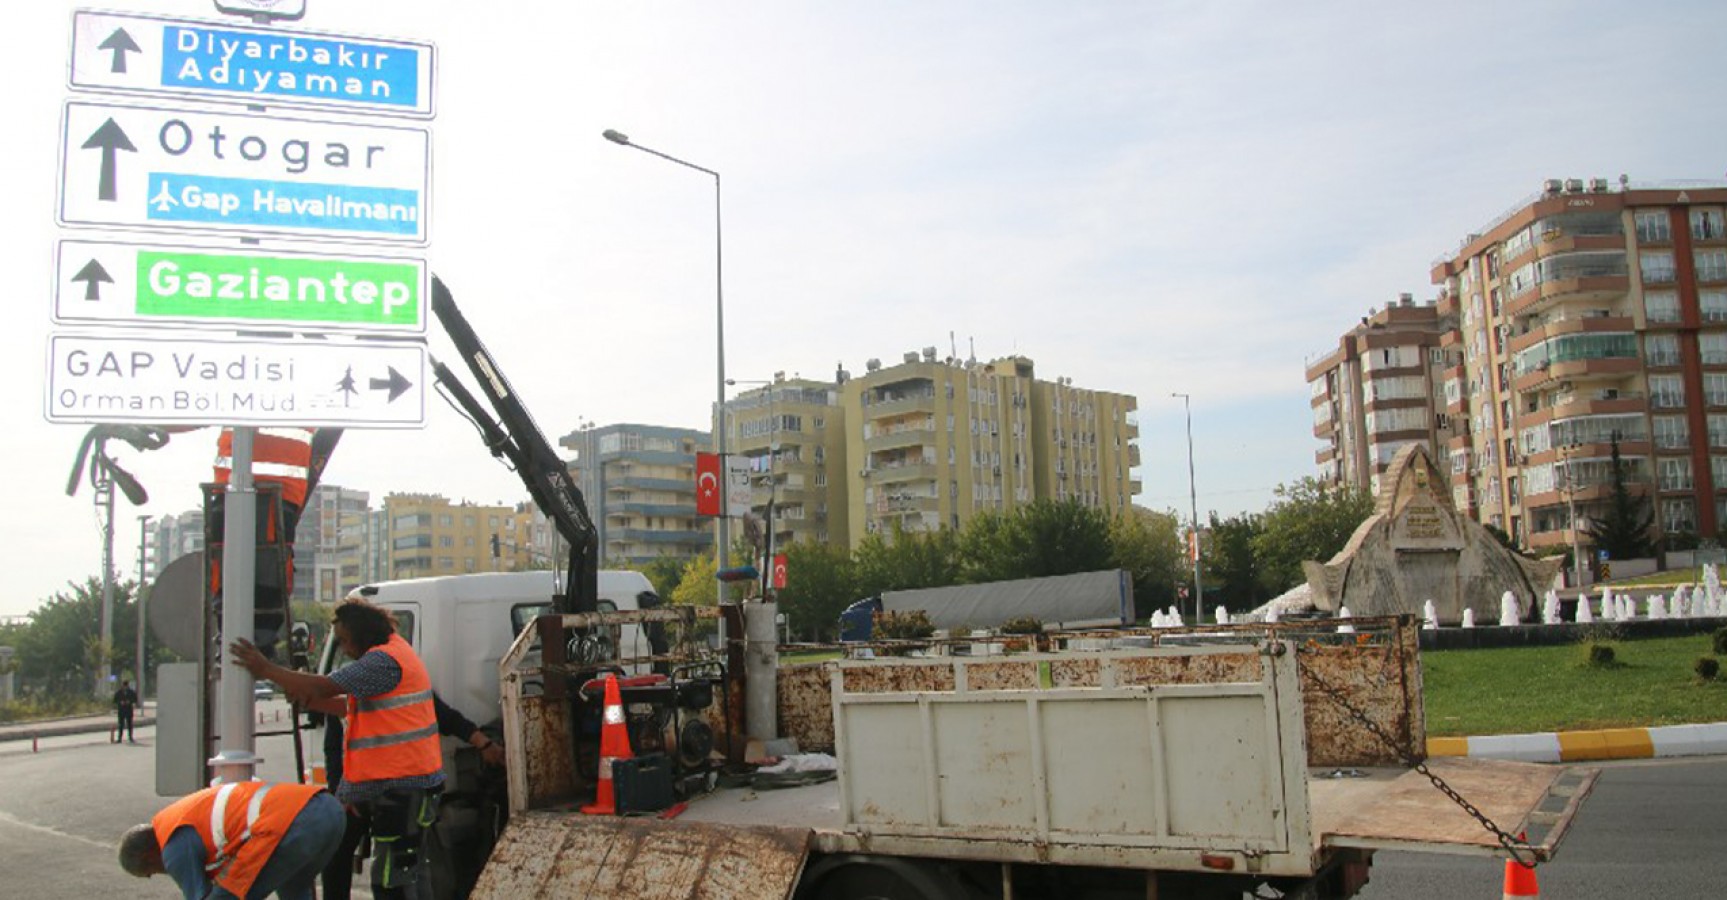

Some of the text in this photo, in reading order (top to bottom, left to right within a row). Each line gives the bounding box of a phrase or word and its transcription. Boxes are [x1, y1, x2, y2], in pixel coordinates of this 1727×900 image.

[177, 29, 389, 70] Diyarbakır
[178, 56, 391, 98] Adıyaman
[159, 118, 385, 173] Otogar
[181, 185, 417, 222] Gap Havalimanı
[148, 260, 411, 315] Gaziantep
[66, 350, 295, 382] GAP Vadisi
[60, 388, 165, 410] Orman
